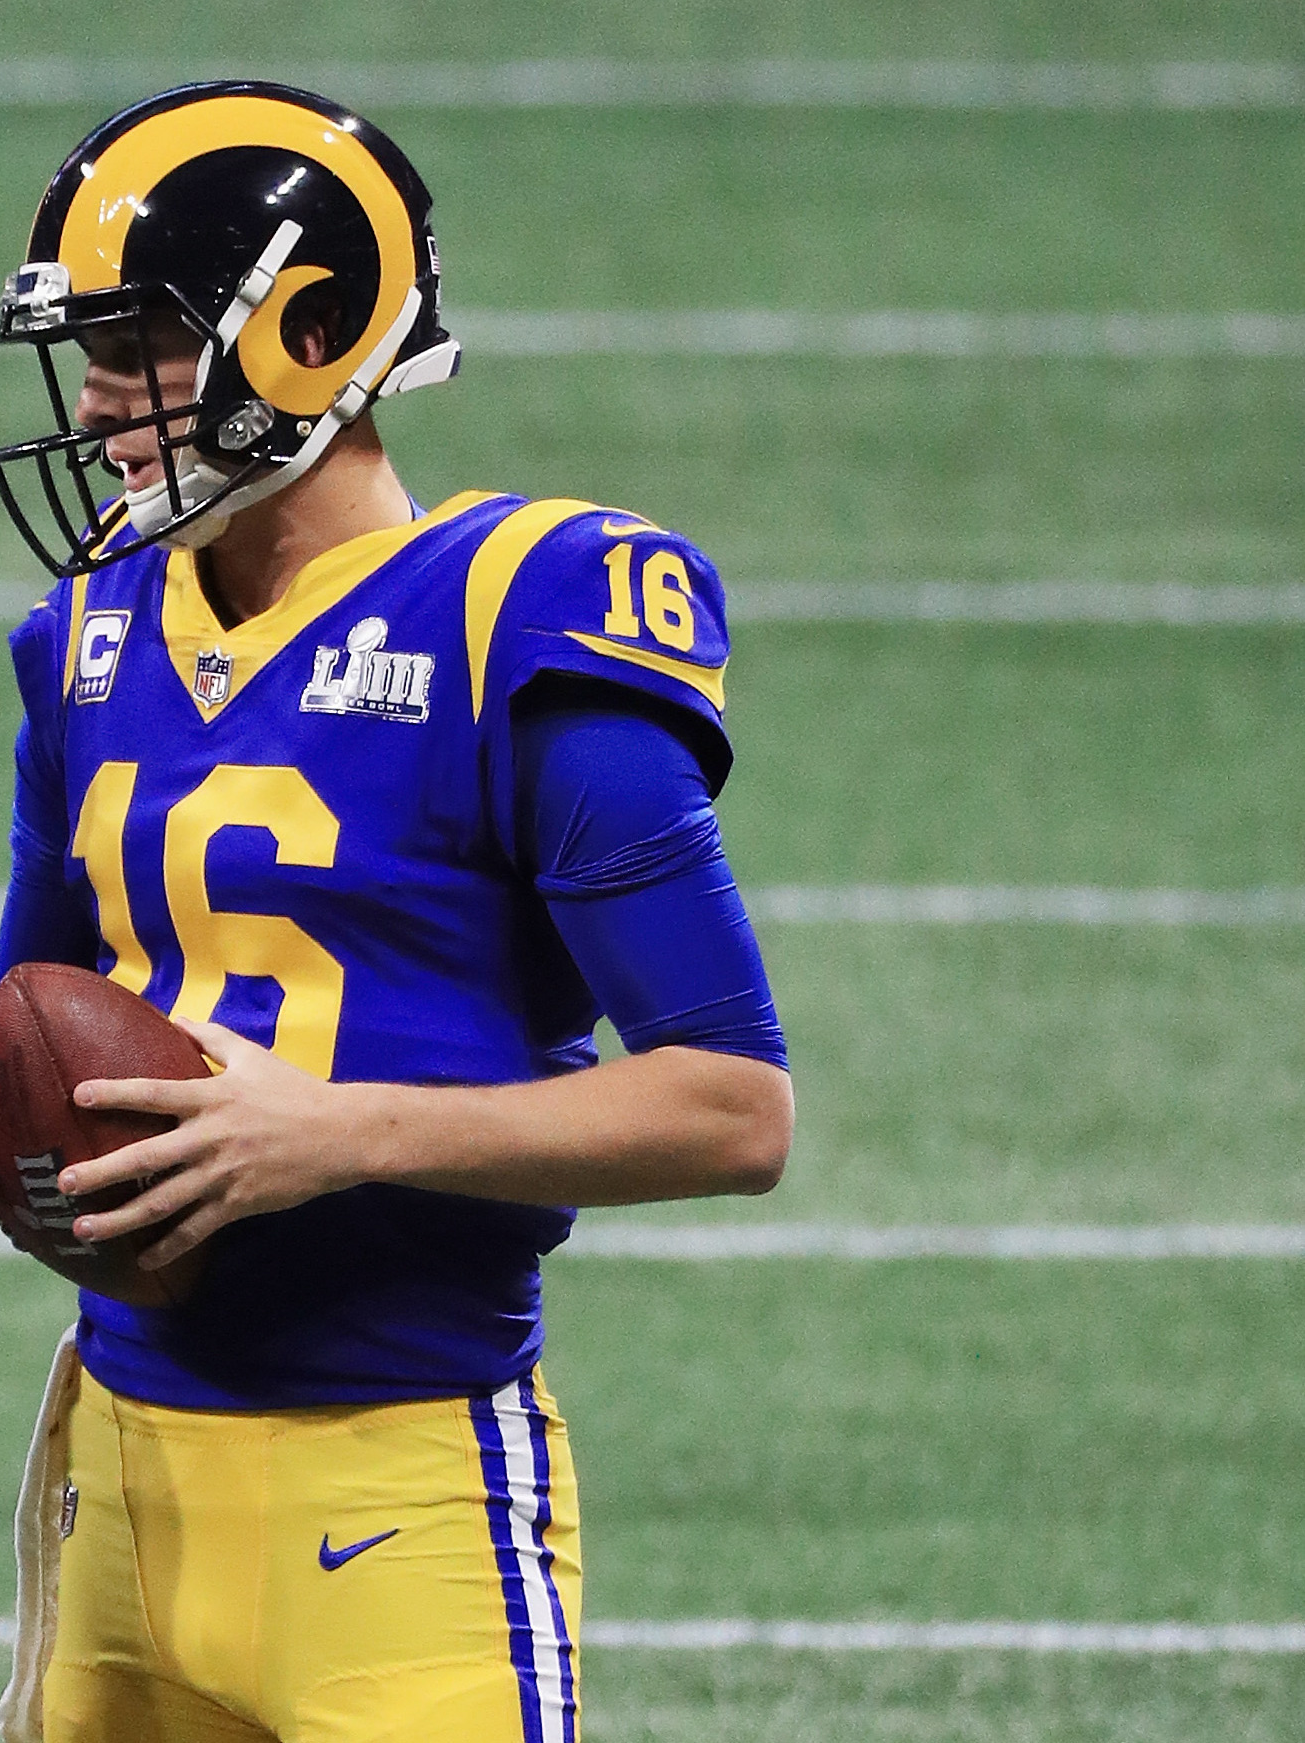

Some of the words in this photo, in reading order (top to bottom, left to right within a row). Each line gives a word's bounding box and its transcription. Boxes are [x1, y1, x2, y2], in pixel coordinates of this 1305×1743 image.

[602, 542, 695, 653] 16
[80, 616, 123, 679] C
[197, 674, 223, 697] NFL
[369, 701, 402, 713] BOWL
[71, 761, 345, 1081] 16
